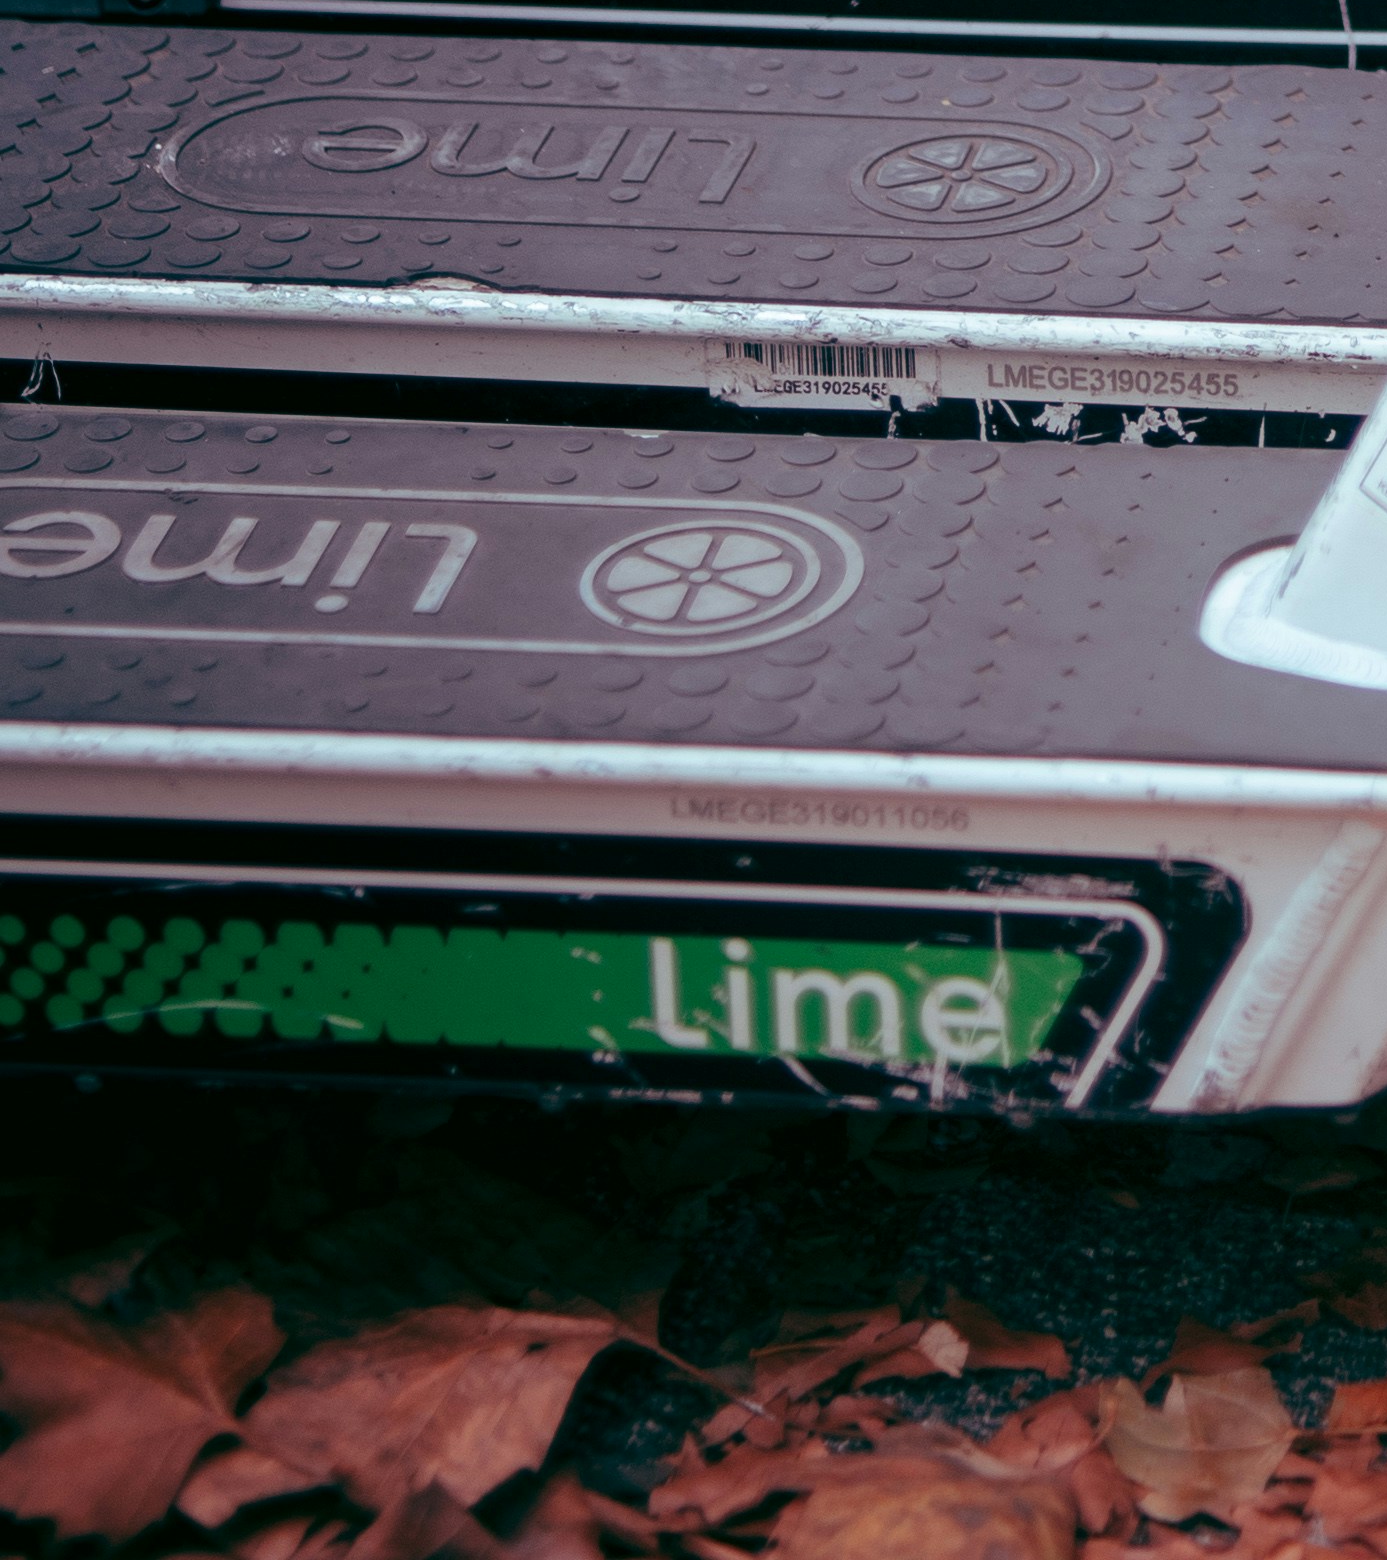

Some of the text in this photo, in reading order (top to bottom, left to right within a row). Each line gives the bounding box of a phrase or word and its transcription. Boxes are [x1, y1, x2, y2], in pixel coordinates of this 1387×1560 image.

[302, 117, 758, 205] Lime
[986, 362, 1240, 398] LMEGE319025455
[0, 511, 478, 614] Lime
[650, 936, 1003, 1063] Lime
